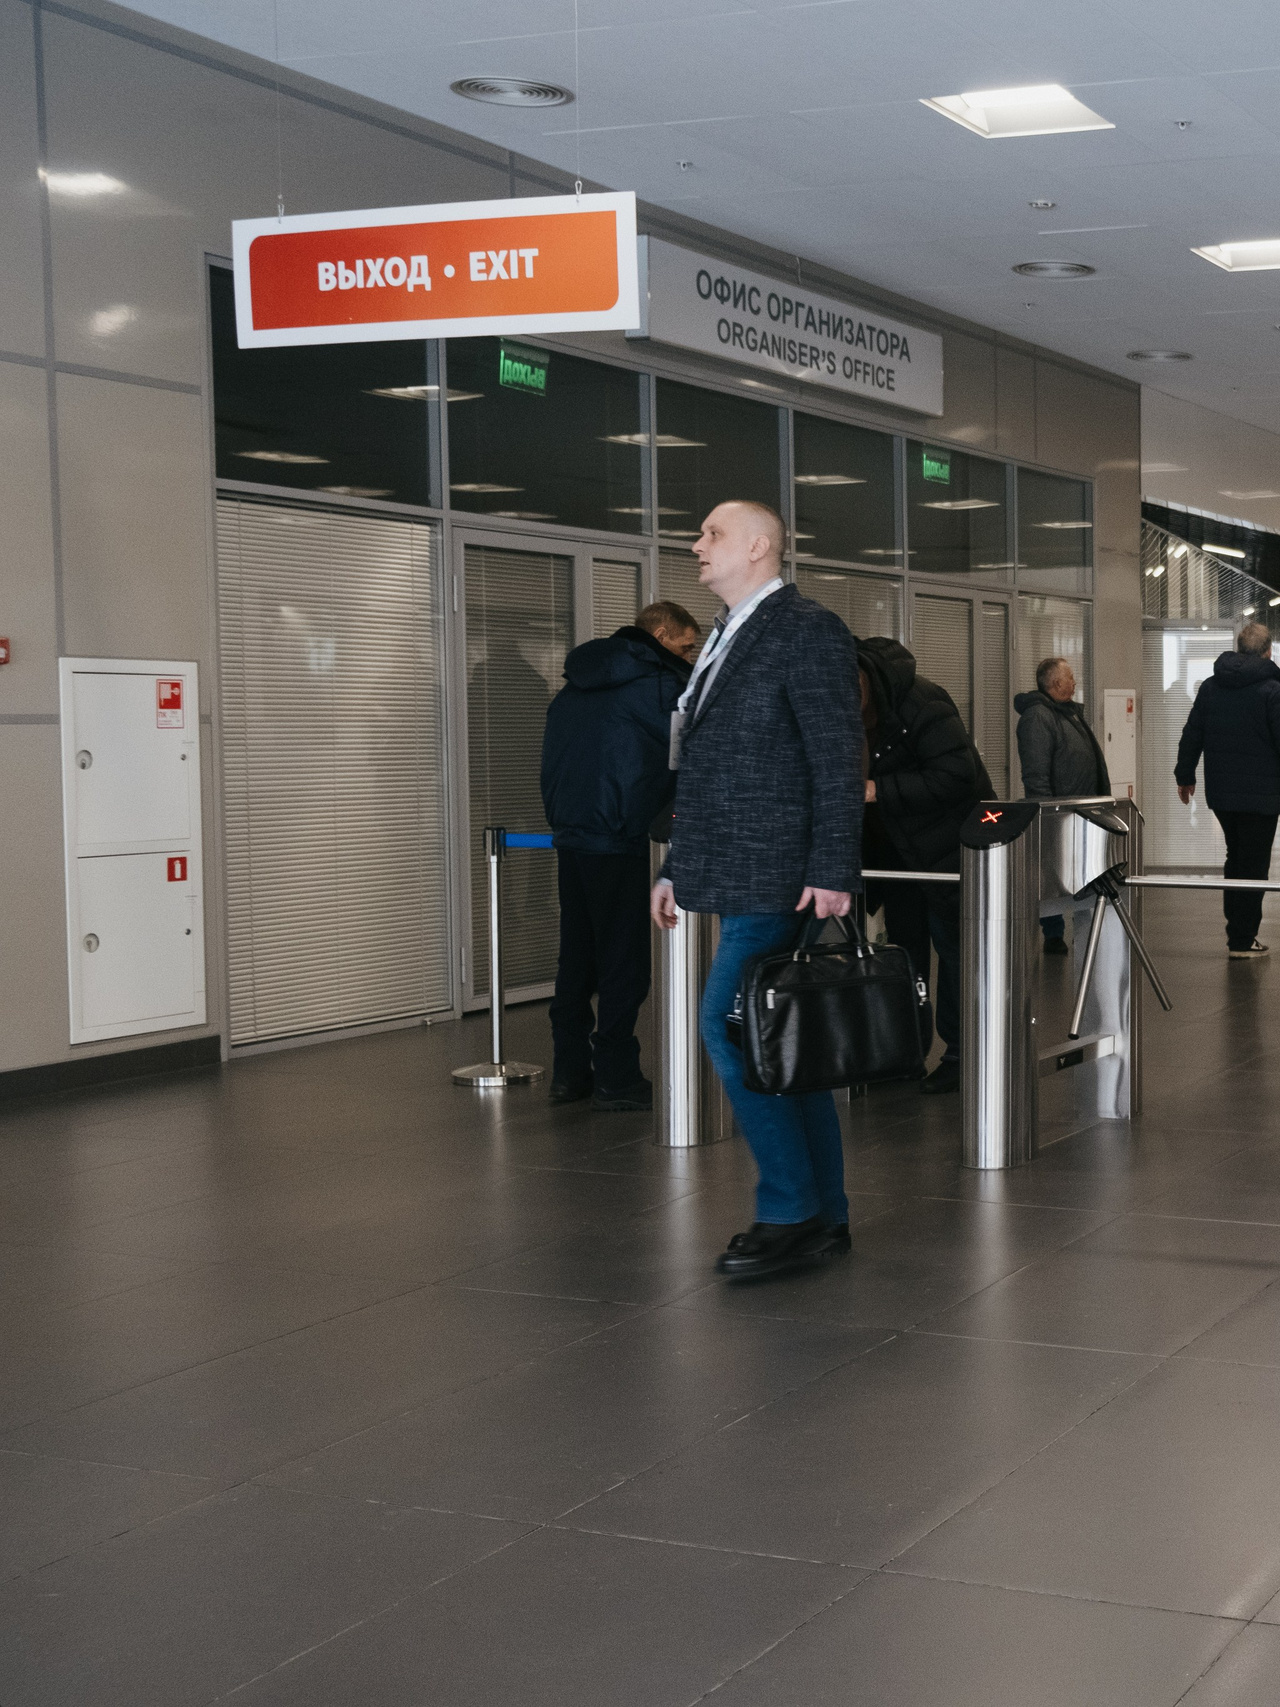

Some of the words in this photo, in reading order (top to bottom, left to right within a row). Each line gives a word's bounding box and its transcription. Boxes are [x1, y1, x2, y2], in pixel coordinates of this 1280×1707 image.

[317, 254, 432, 293] ВЫХОД
[469, 248, 539, 282] EXIT
[696, 269, 762, 316] ОФИС
[767, 292, 912, 363] ОРГАНИЗАТОРА
[842, 356, 896, 392] OFFICE
